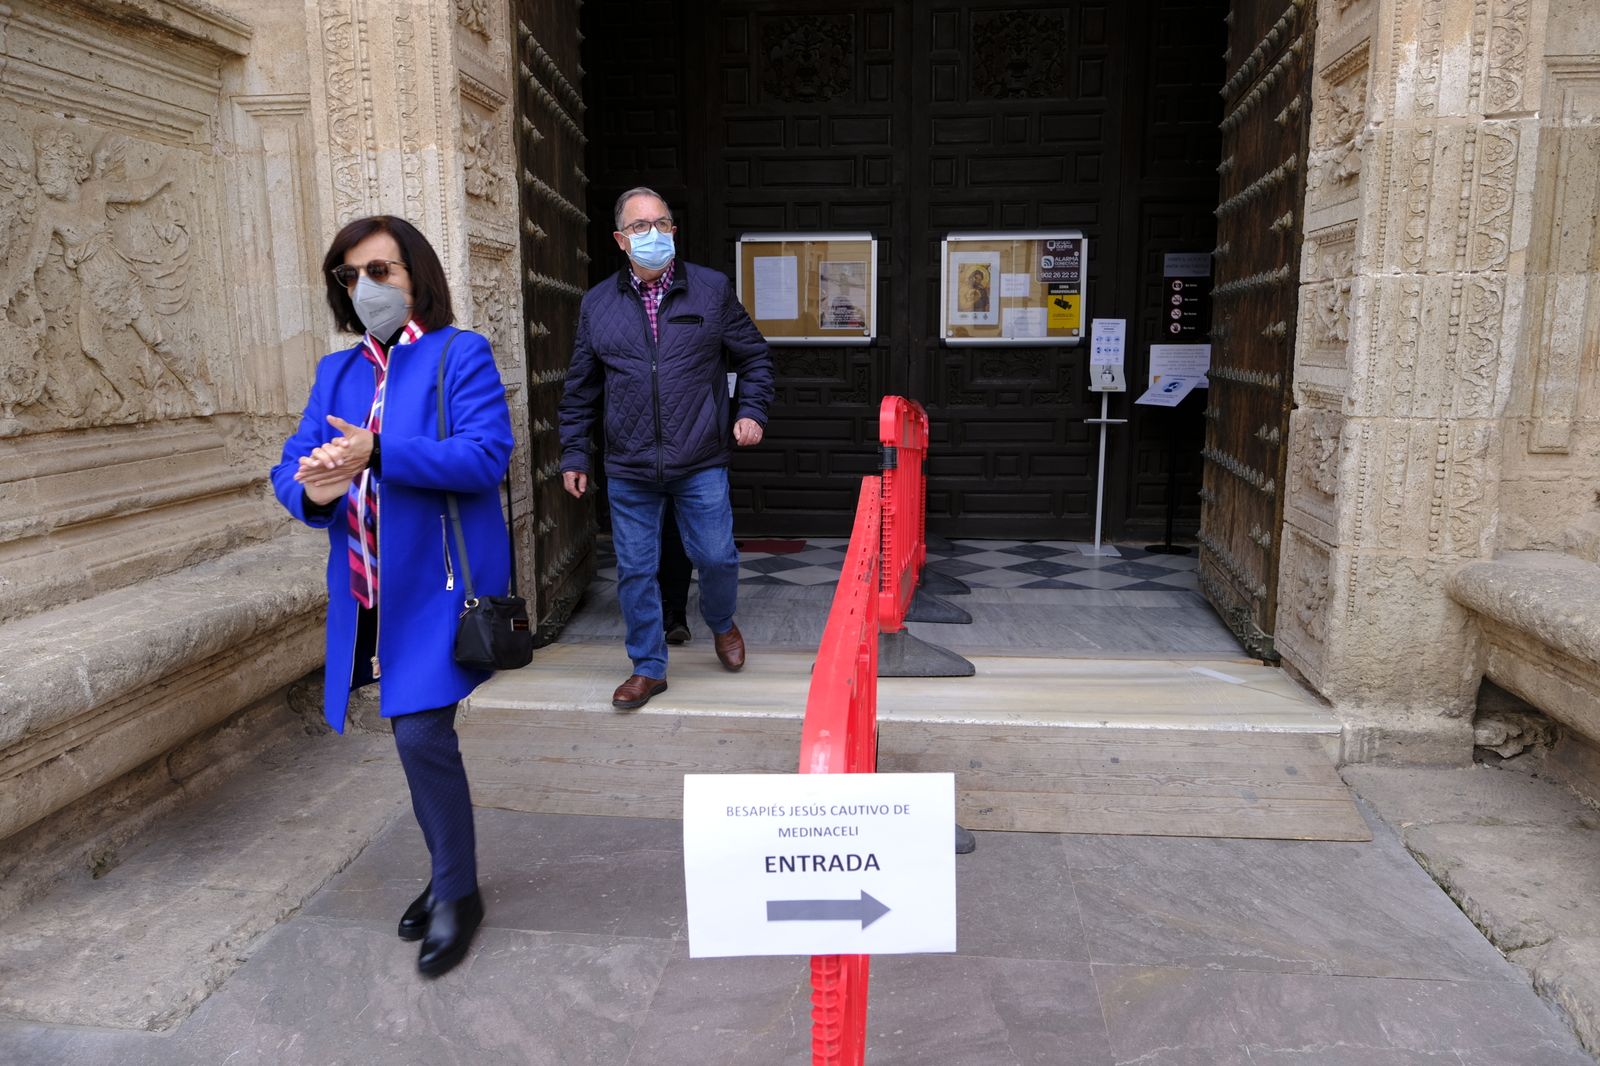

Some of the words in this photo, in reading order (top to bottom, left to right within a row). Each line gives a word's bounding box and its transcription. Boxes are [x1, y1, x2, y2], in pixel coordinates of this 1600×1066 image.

[726, 804, 785, 817] BESAPIÉS
[789, 802, 827, 817] JESÚS
[830, 804, 890, 816] CAUTIVO
[894, 804, 910, 815] DE
[778, 826, 859, 838] MEDINACELI
[765, 853, 881, 873] ENTRADA
